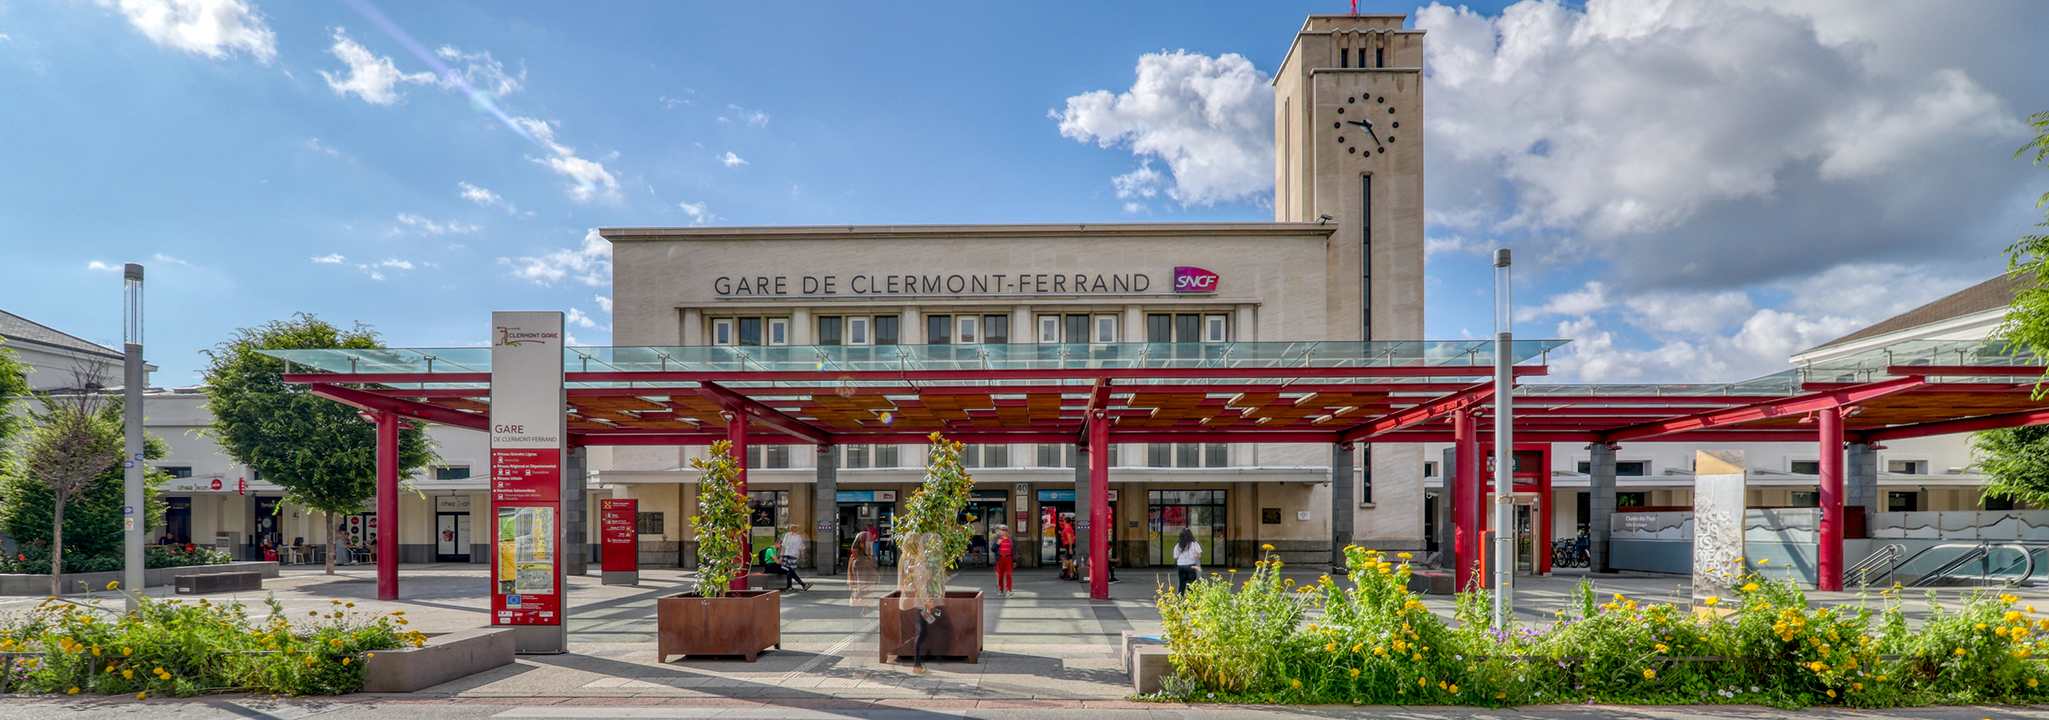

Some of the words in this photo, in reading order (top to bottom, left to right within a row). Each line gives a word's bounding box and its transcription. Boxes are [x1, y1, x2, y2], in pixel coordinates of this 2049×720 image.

[714, 276, 787, 295] GARE
[802, 275, 836, 294] DE
[851, 274, 1150, 294] CLERMONT-FERRAND
[1175, 275, 1217, 288] SNCF
[494, 424, 524, 434] GARE
[194, 483, 209, 491] jean
